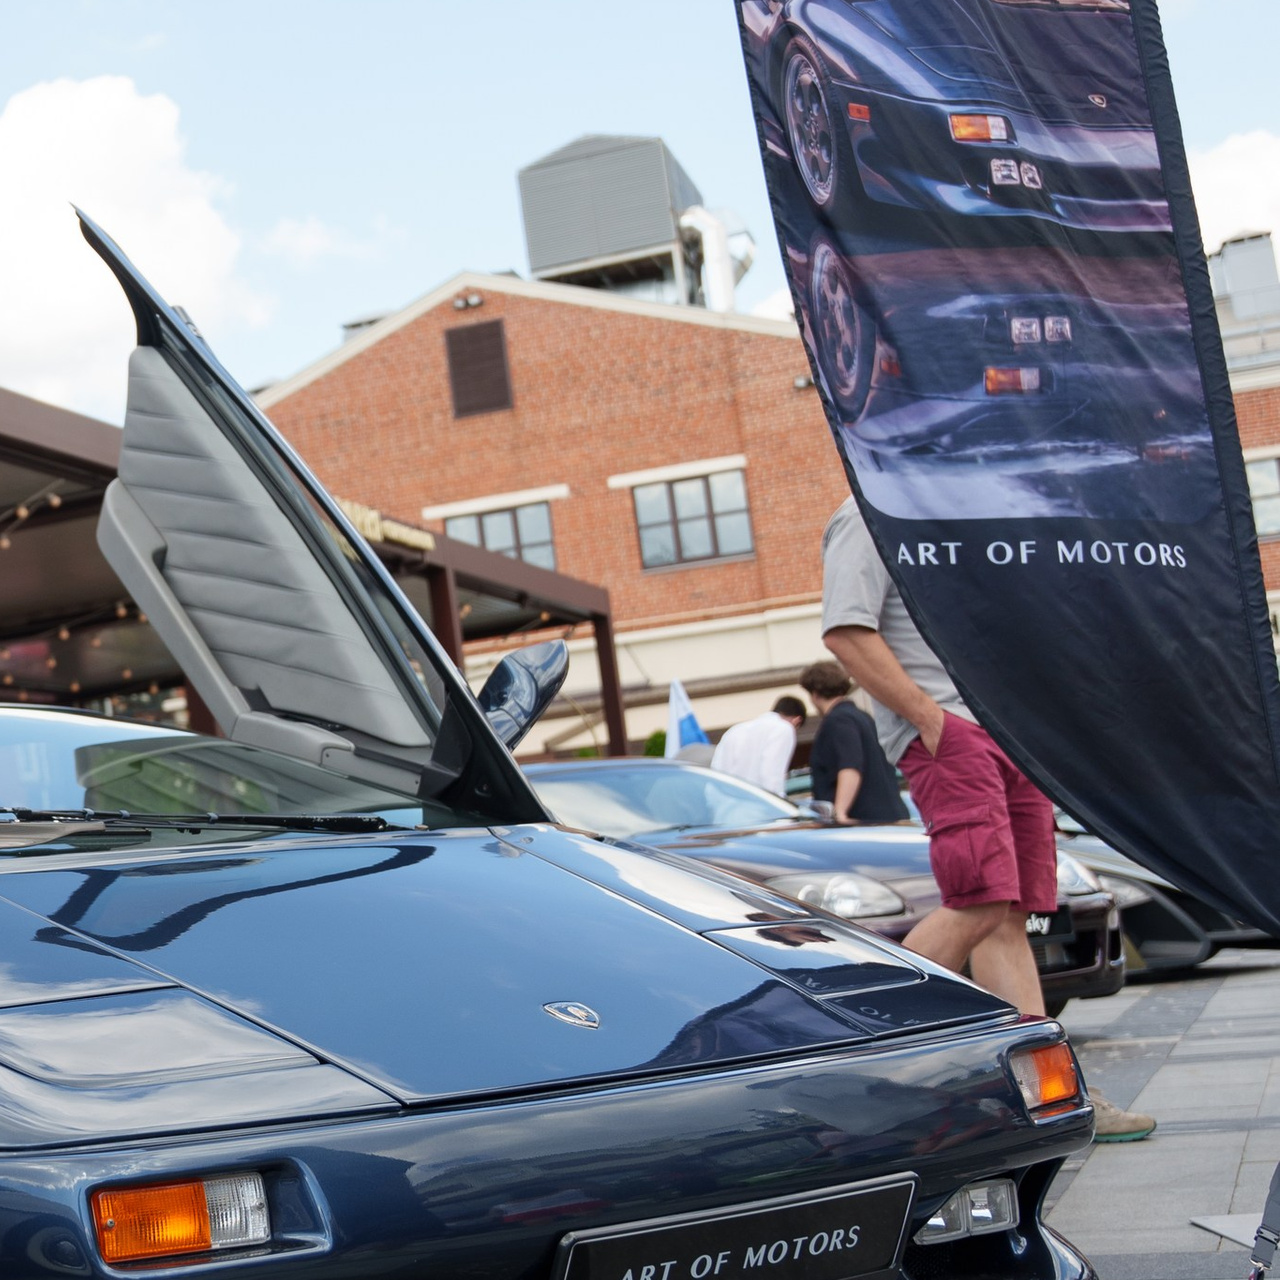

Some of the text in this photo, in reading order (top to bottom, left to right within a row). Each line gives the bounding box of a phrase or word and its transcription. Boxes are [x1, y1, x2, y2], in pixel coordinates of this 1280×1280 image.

[897, 539, 1187, 568] ART OF MOTORS
[690, 1251, 731, 1279] OF
[743, 1225, 861, 1269] MOTORS
